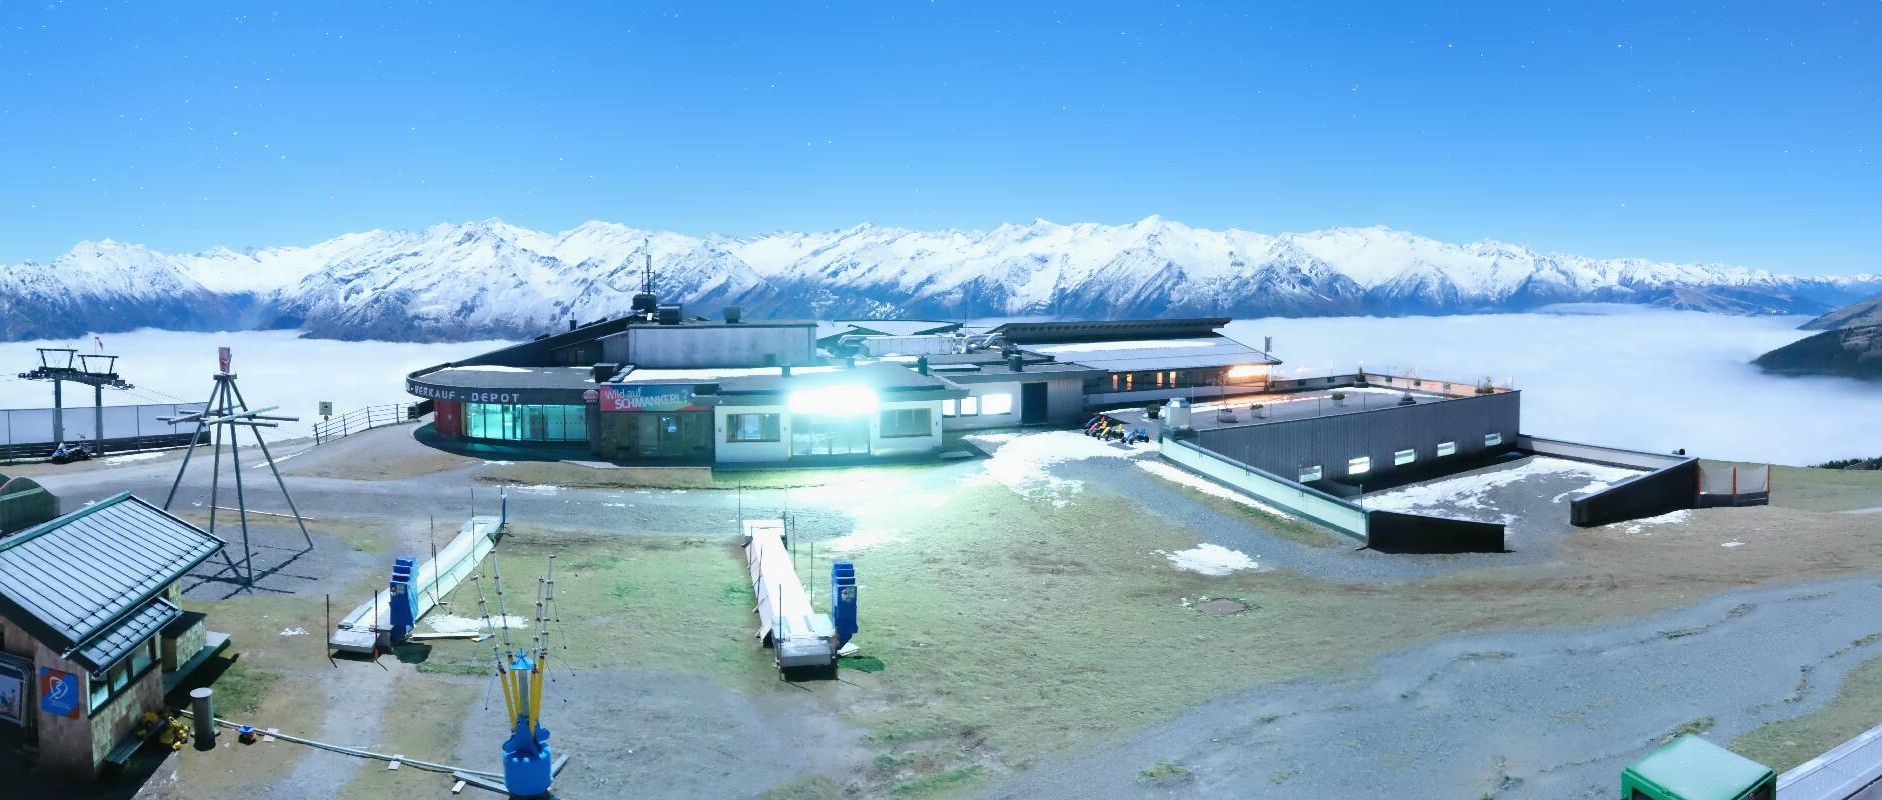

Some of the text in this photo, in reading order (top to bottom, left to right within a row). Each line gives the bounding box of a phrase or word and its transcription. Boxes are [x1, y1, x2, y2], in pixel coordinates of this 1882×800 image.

[415, 385, 456, 400] VERKAUF
[471, 392, 520, 403] DEPOT
[604, 388, 625, 400] Wild
[626, 386, 643, 399] auf
